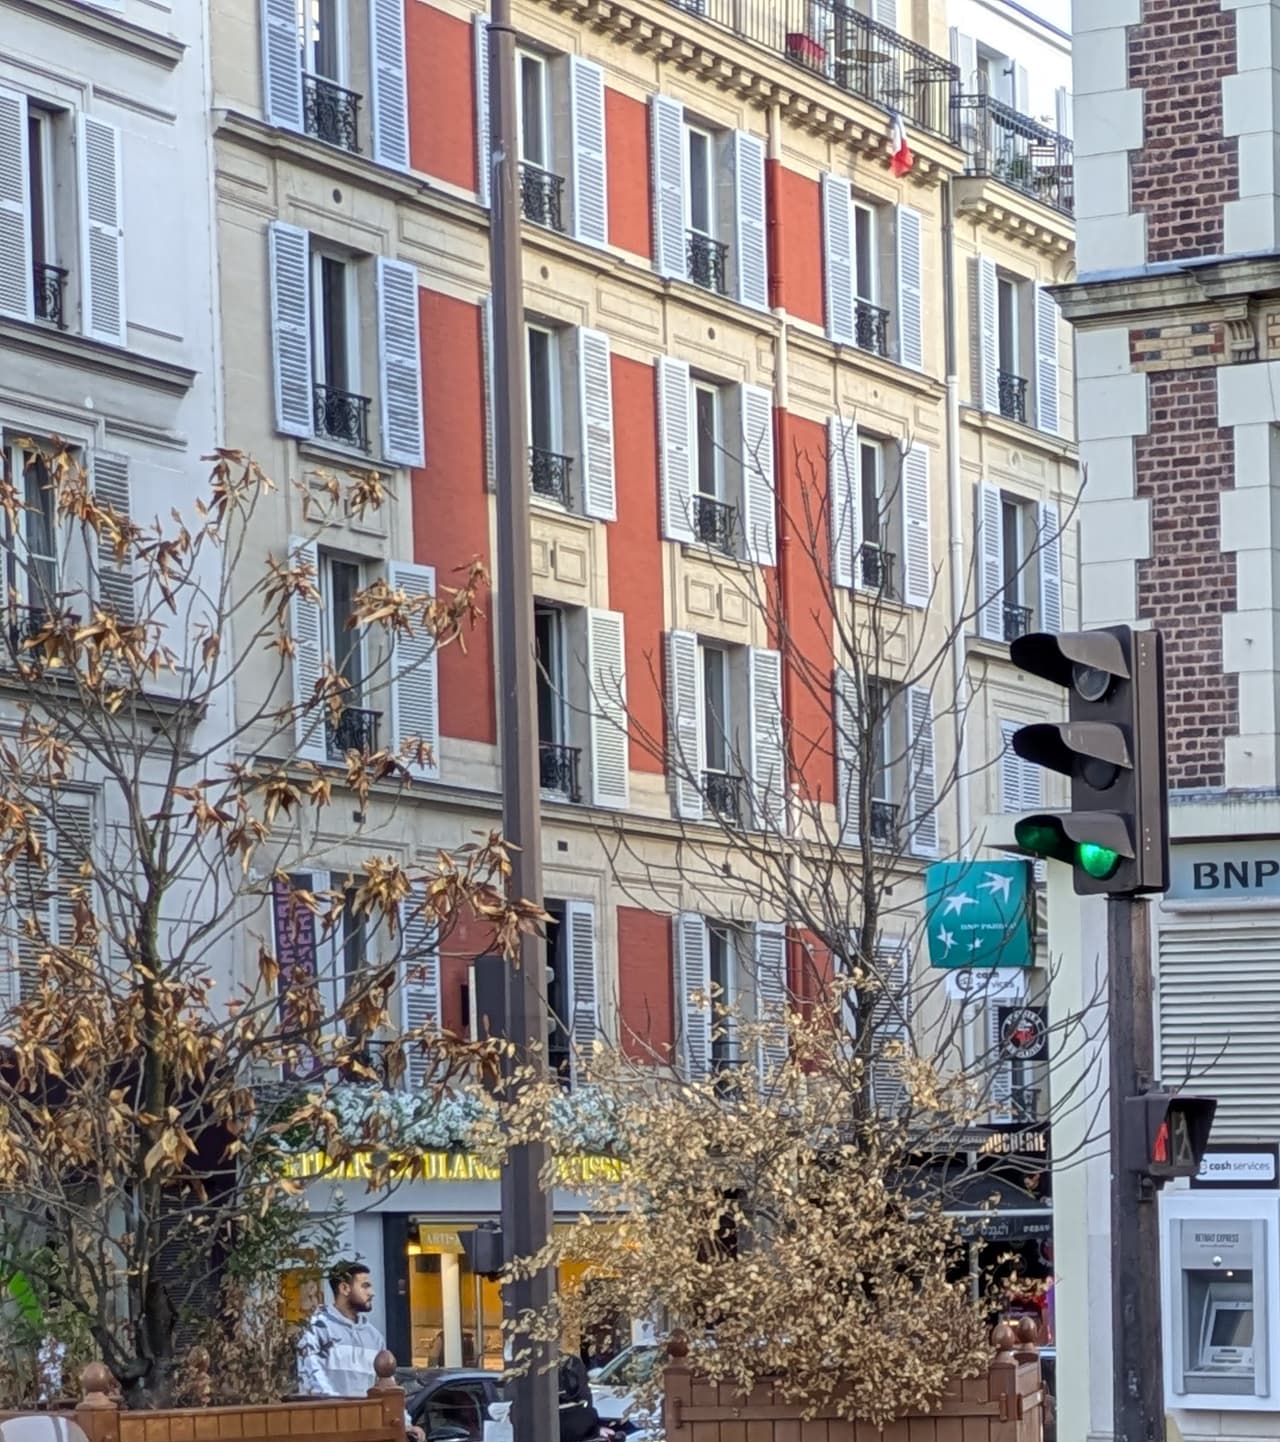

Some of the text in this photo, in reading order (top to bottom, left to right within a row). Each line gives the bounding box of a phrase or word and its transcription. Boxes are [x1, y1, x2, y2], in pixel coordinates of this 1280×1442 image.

[1193, 860, 1280, 890] BNP
[1209, 1160, 1270, 1171] cash services
